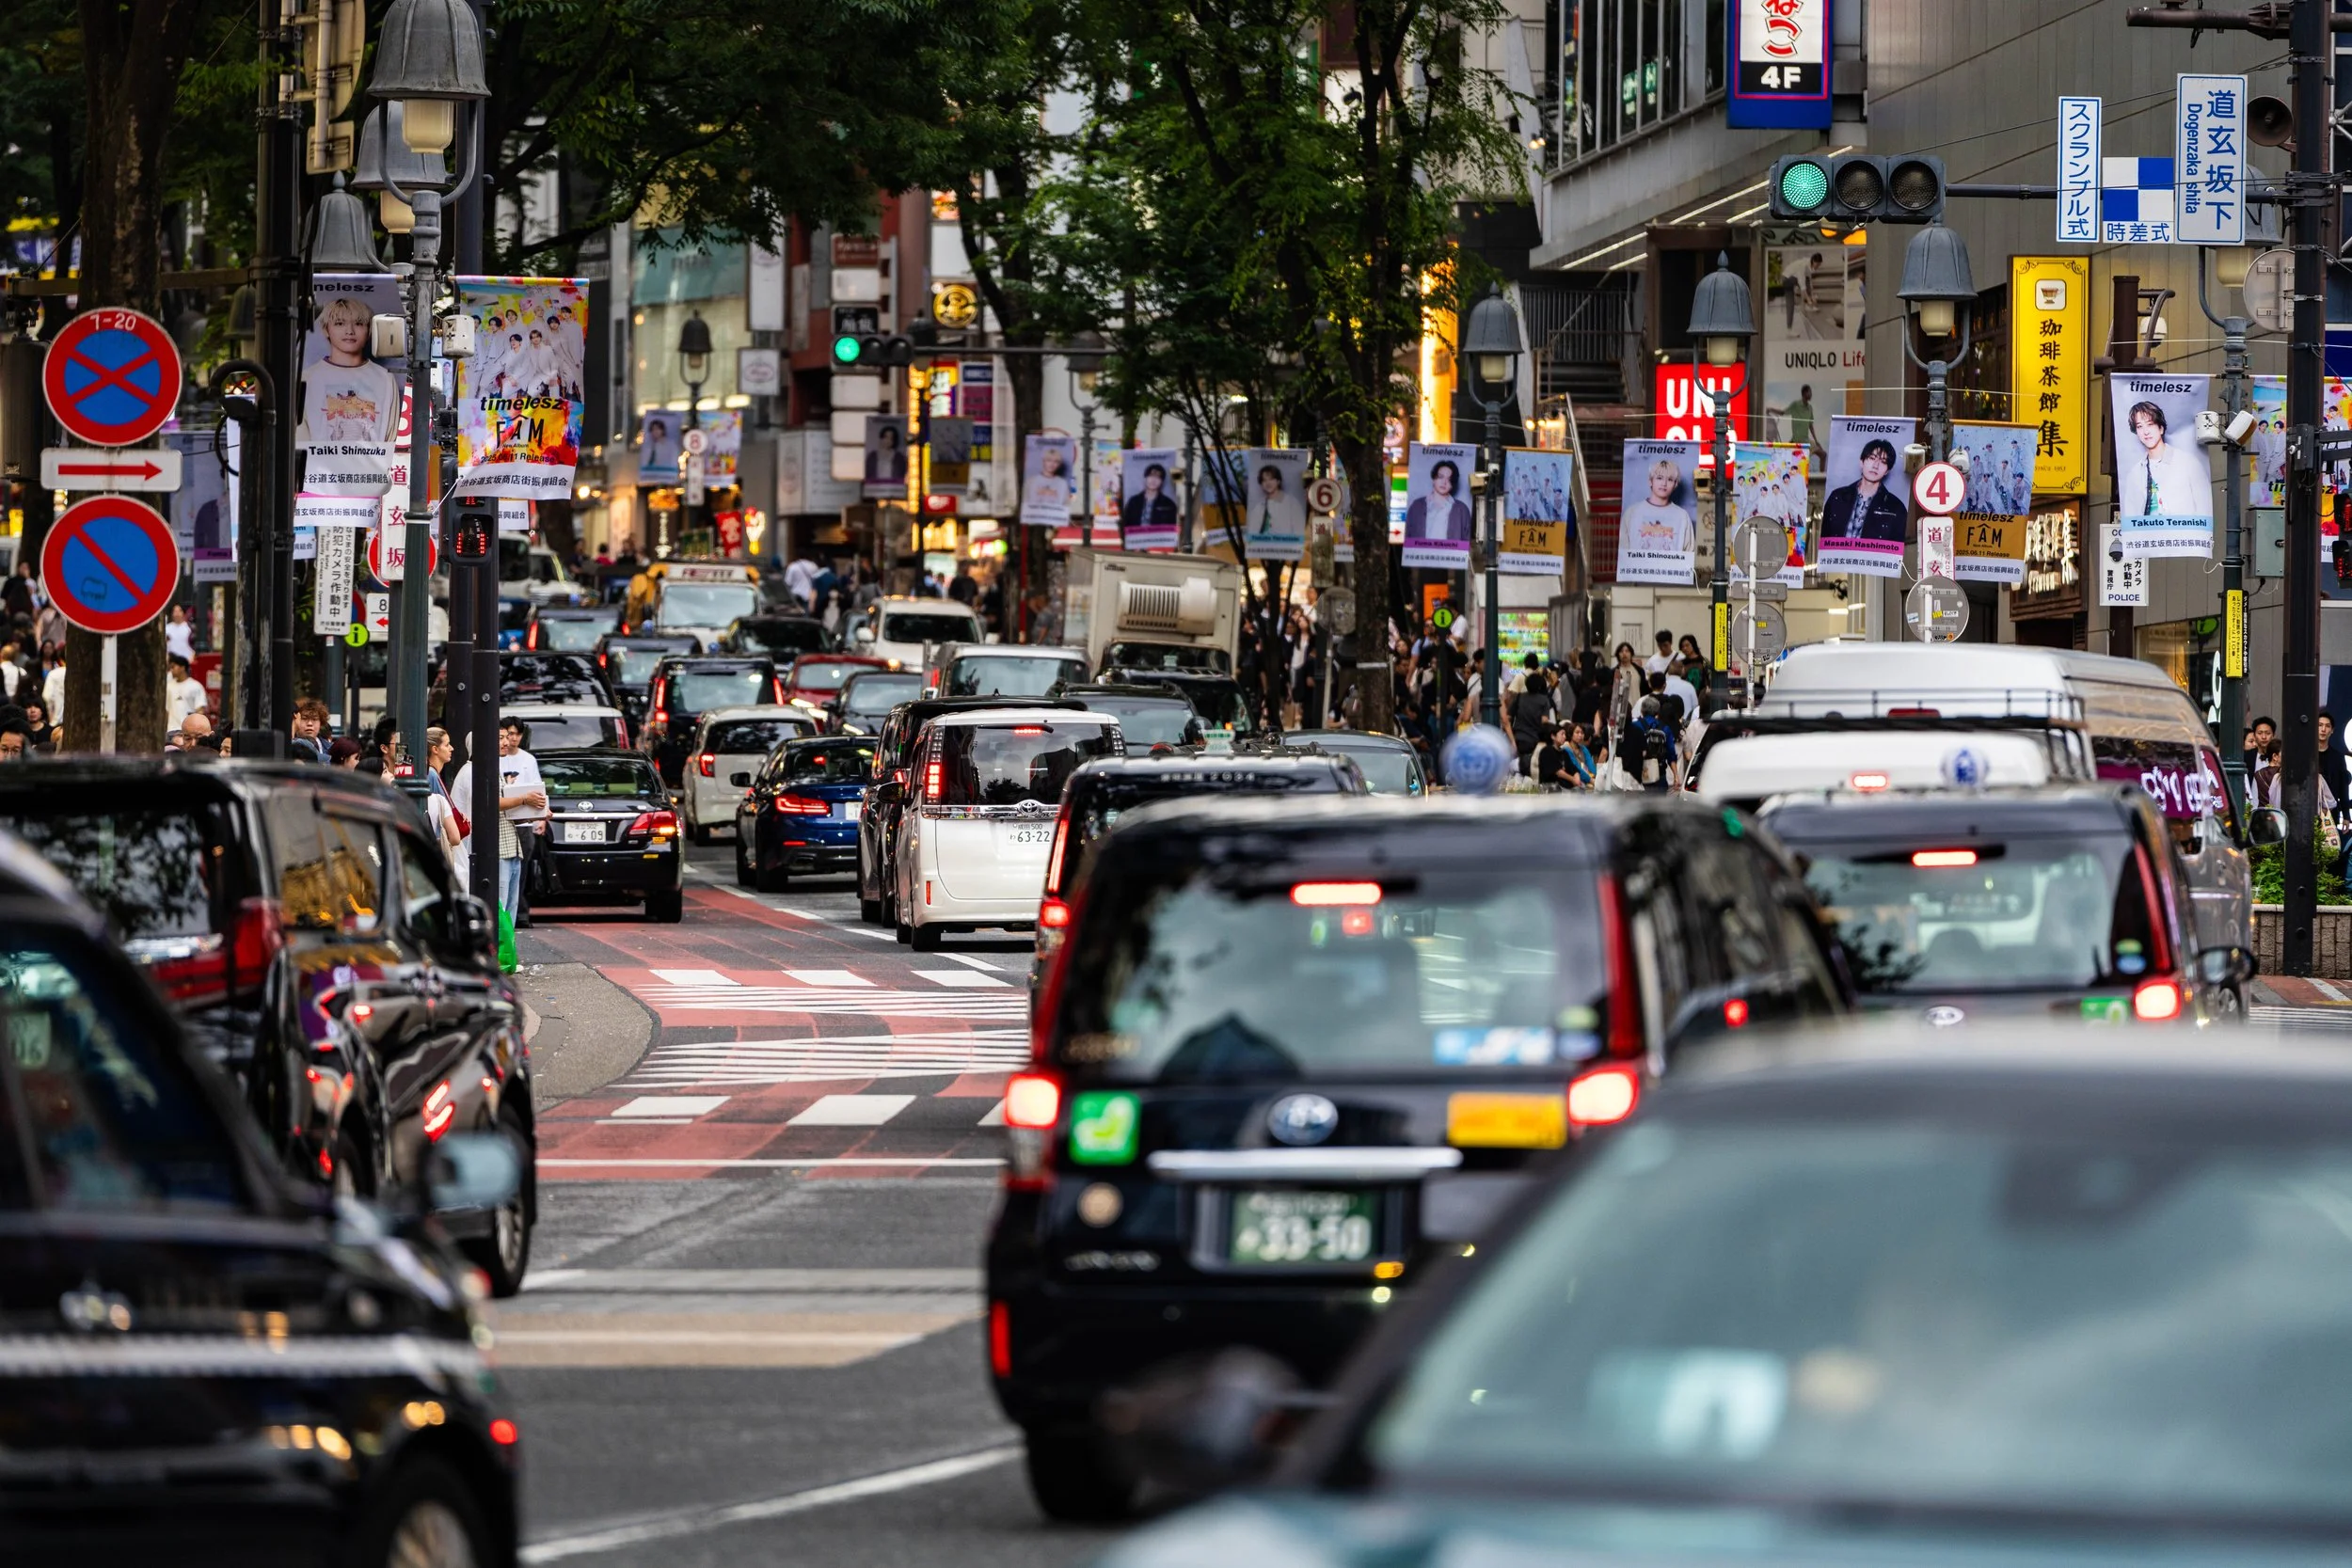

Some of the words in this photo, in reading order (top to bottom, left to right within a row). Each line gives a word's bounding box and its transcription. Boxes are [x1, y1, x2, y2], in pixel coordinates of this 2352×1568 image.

[1761, 66, 1801, 88] 4F
[2185, 103, 2202, 176] Dogenzaka
[2204, 89, 2236, 230] 道玄坂下
[2067, 103, 2091, 237] スクランブル式
[2185, 182, 2199, 214] shita
[2106, 222, 2170, 243] 時差式
[1785, 352, 1836, 371] UNIQLO
[2129, 380, 2192, 393] timelesz
[481, 396, 563, 411] timelesz
[1666, 377, 1731, 419] UNI
[1846, 421, 1900, 434] timelesz
[309, 446, 338, 455] Taiki
[342, 446, 387, 456] Shinozuka
[1422, 446, 1465, 457] timelesz
[1638, 444, 1686, 454] timelesz
[519, 452, 555, 463] Release
[460, 475, 568, 487] 渋谷道玄坂商店街振興組合
[1926, 471, 1950, 505] 4
[1316, 483, 1333, 507] 6
[388, 465, 407, 569] 道玄坂
[1959, 510, 2015, 523] timelesz
[2167, 518, 2207, 527] Teranishi
[1854, 541, 1899, 551] Hashimoto
[1646, 552, 1686, 561] Shinozuka
[2123, 562, 2133, 590] 作動中
[2134, 558, 2142, 586] カメラ
[378, 598, 388, 611] 8
[2108, 594, 2140, 602] POLICE
[1017, 831, 1050, 843] 63-22
